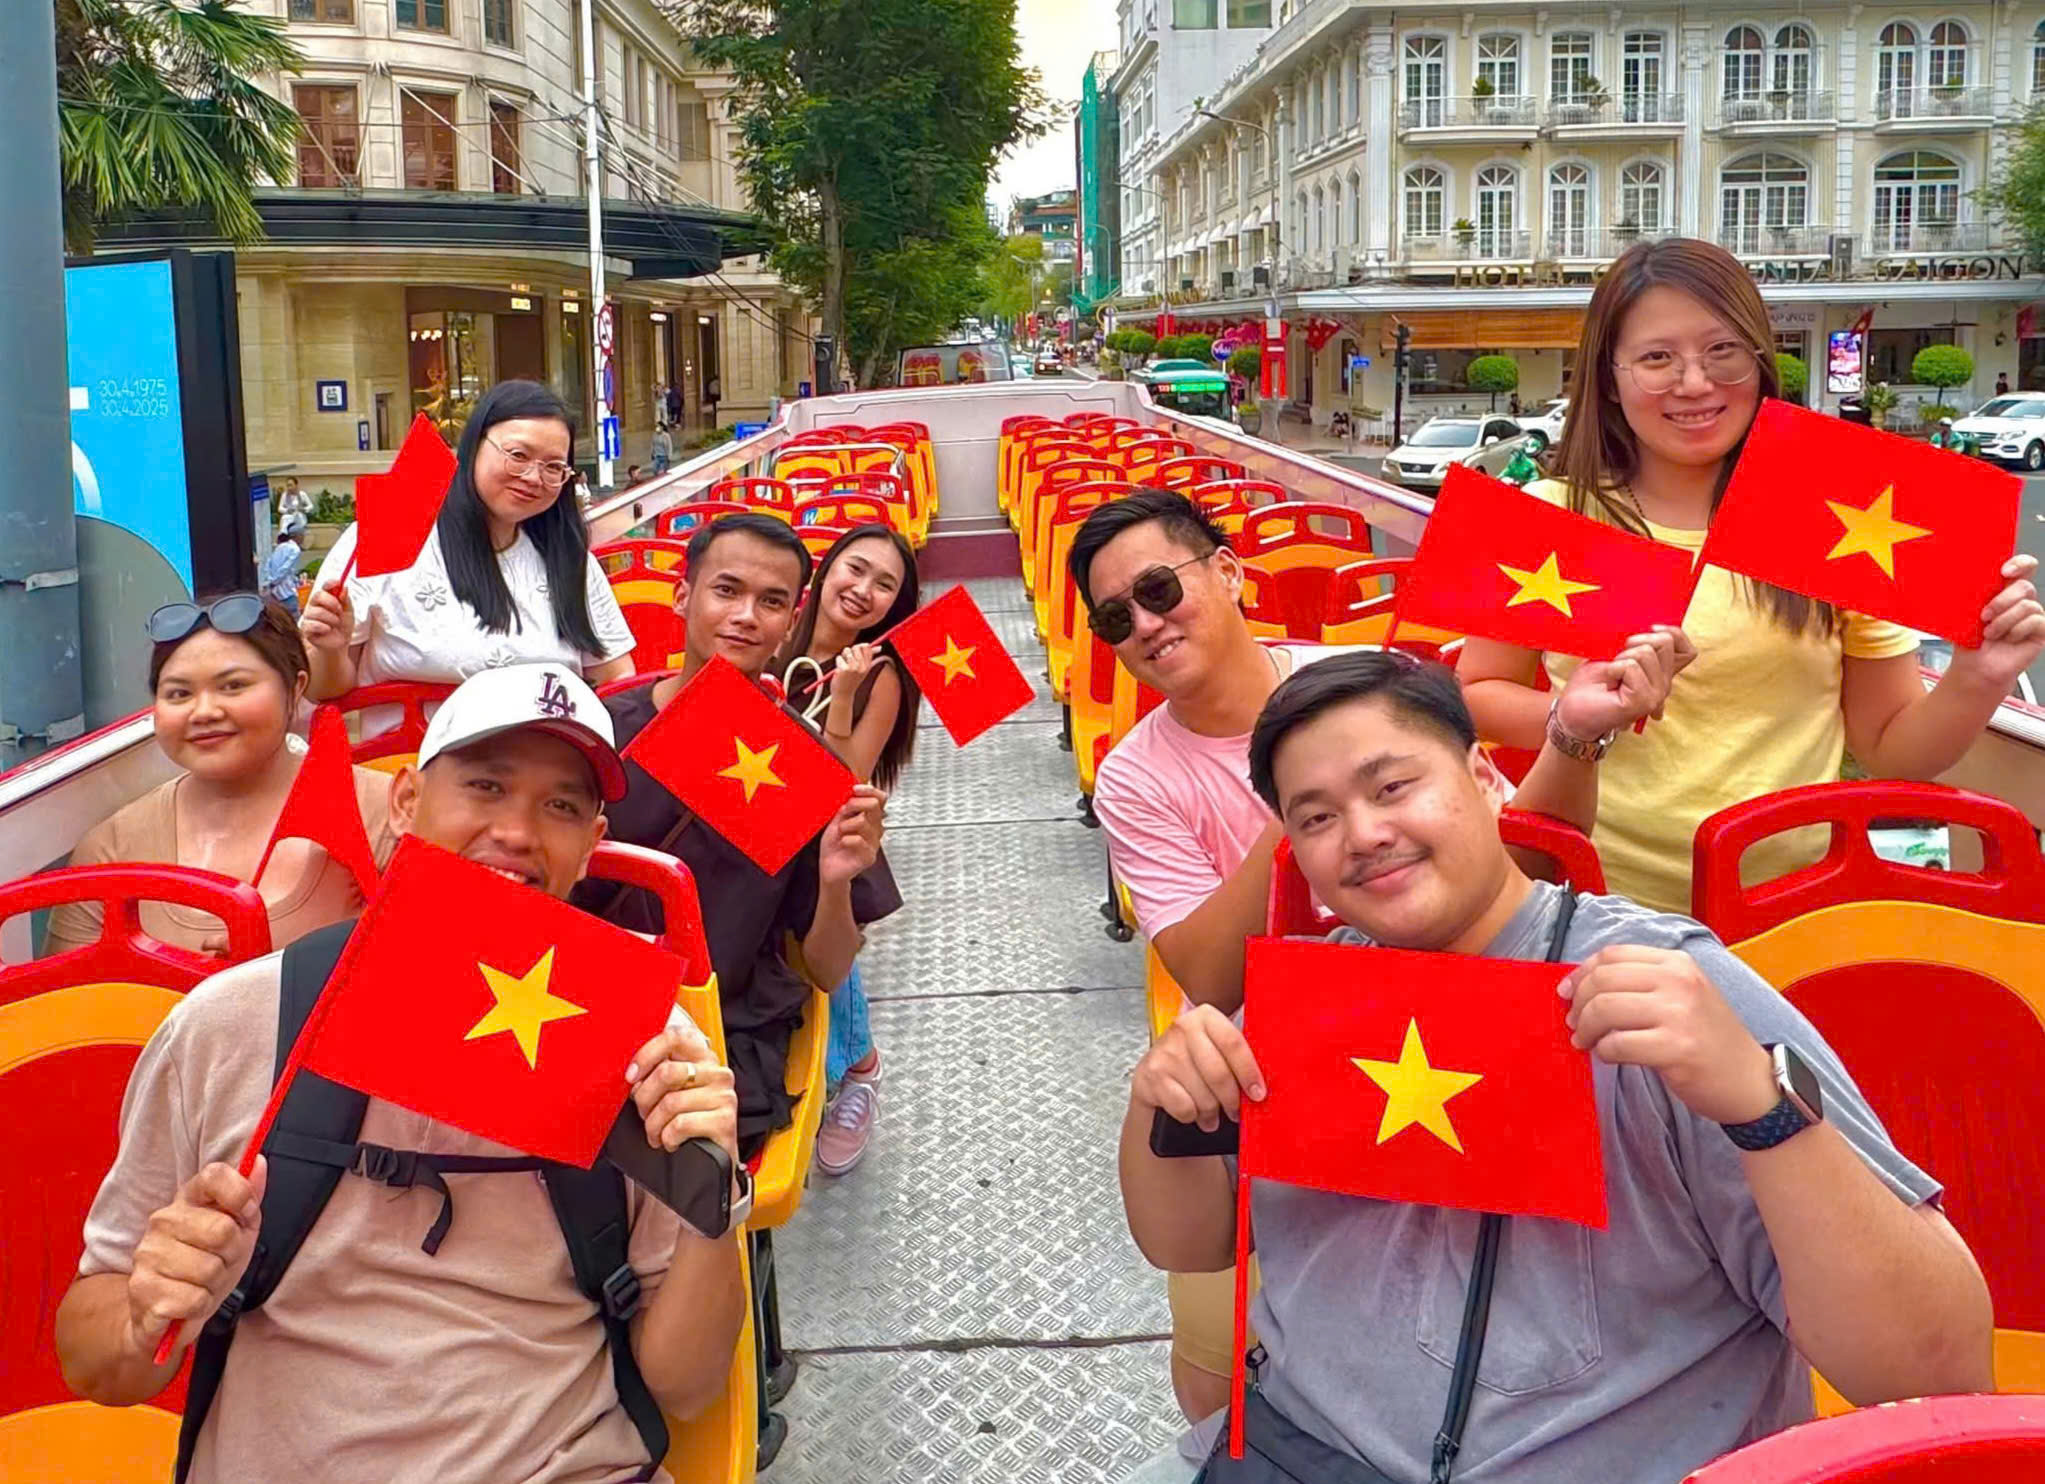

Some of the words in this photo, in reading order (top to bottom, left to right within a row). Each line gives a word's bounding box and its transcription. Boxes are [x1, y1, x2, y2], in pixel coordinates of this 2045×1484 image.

[1455, 263, 1573, 289] HOTEL
[1874, 256, 2023, 282] SAIGON
[99, 378, 167, 398] 30.4.1975
[100, 399, 168, 417] 30.4.2025
[538, 672, 577, 719] LA
